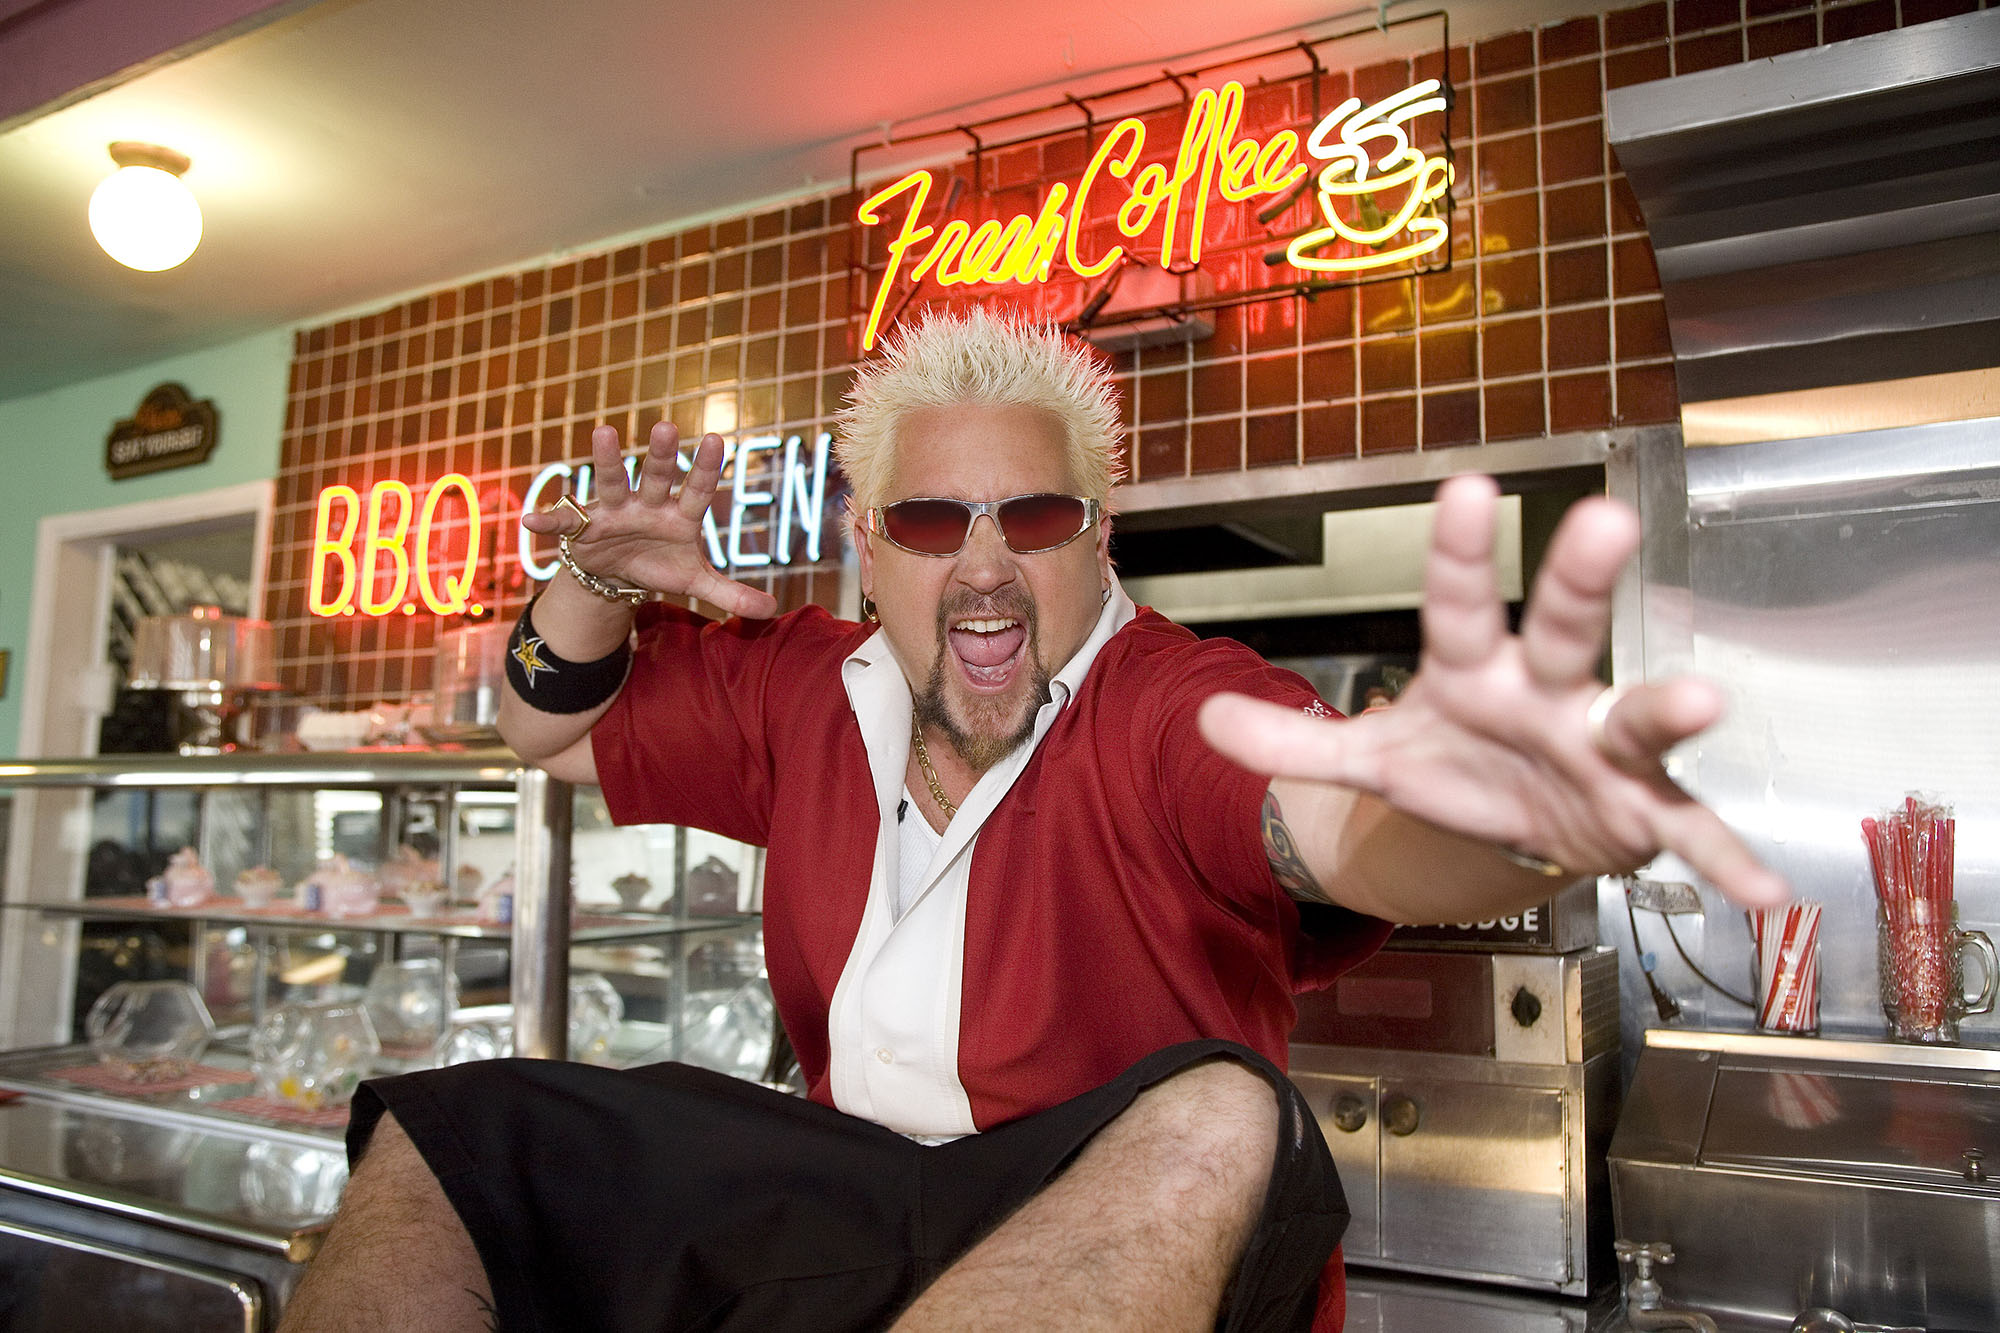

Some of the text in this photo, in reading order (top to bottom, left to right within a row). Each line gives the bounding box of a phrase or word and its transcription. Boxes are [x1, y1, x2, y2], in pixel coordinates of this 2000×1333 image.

[858, 80, 1309, 352] Fresh Coffee
[309, 473, 484, 616] B.B.Q.
